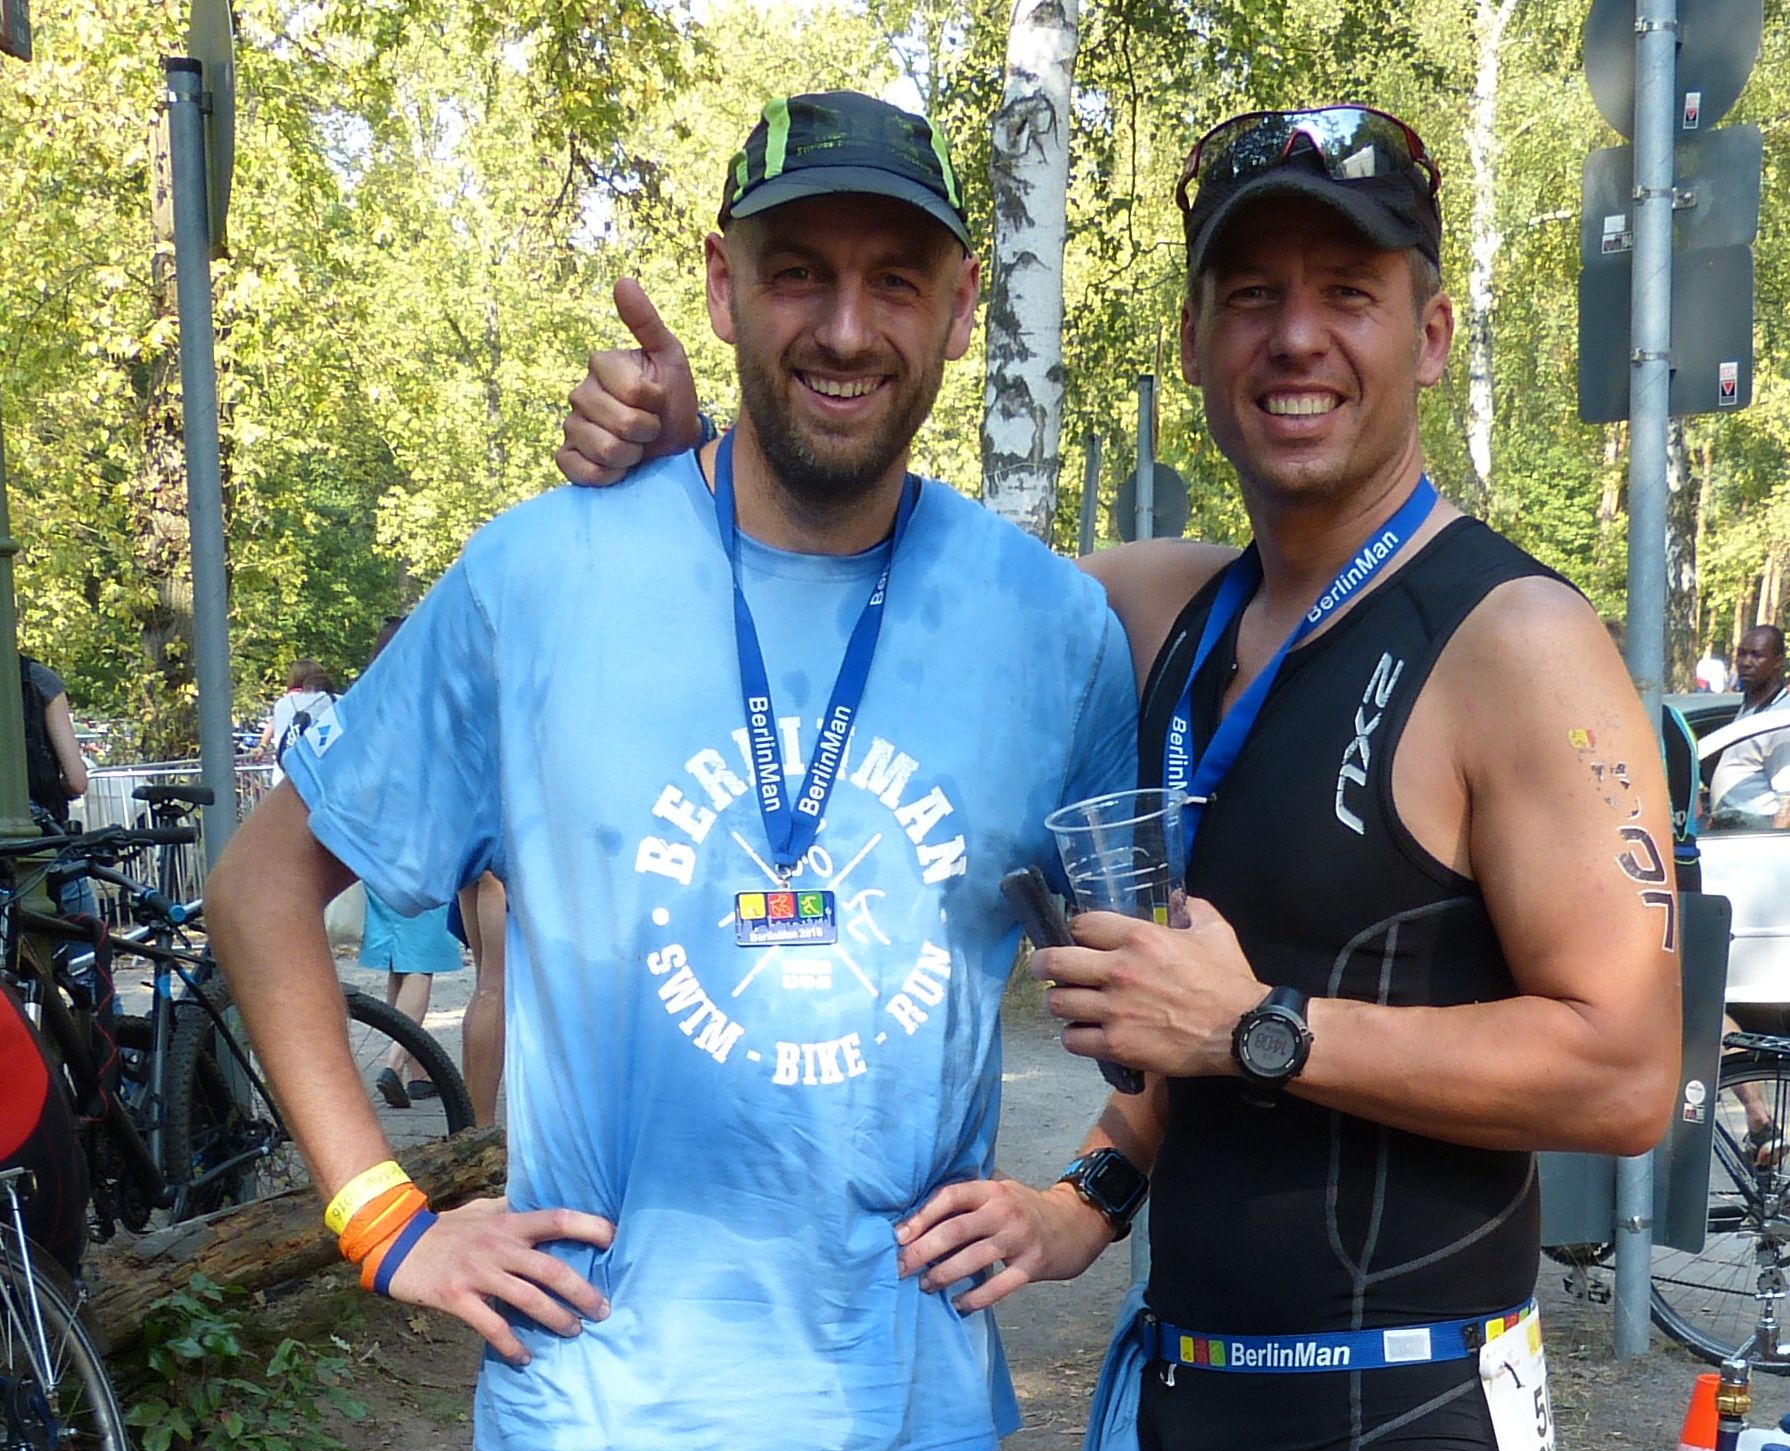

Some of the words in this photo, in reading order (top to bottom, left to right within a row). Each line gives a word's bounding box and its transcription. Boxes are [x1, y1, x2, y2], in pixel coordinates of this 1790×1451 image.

[1306, 531, 1399, 623] BerlinMan
[748, 696, 780, 813] BerlinMan
[798, 705, 852, 817] BerlinMan
[1335, 652, 1403, 836] 2XU
[647, 944, 744, 1064] SWIM
[772, 1032, 867, 1086] BIKE
[885, 941, 951, 1036] RUN
[1231, 1342, 1350, 1367] BerlinMan
